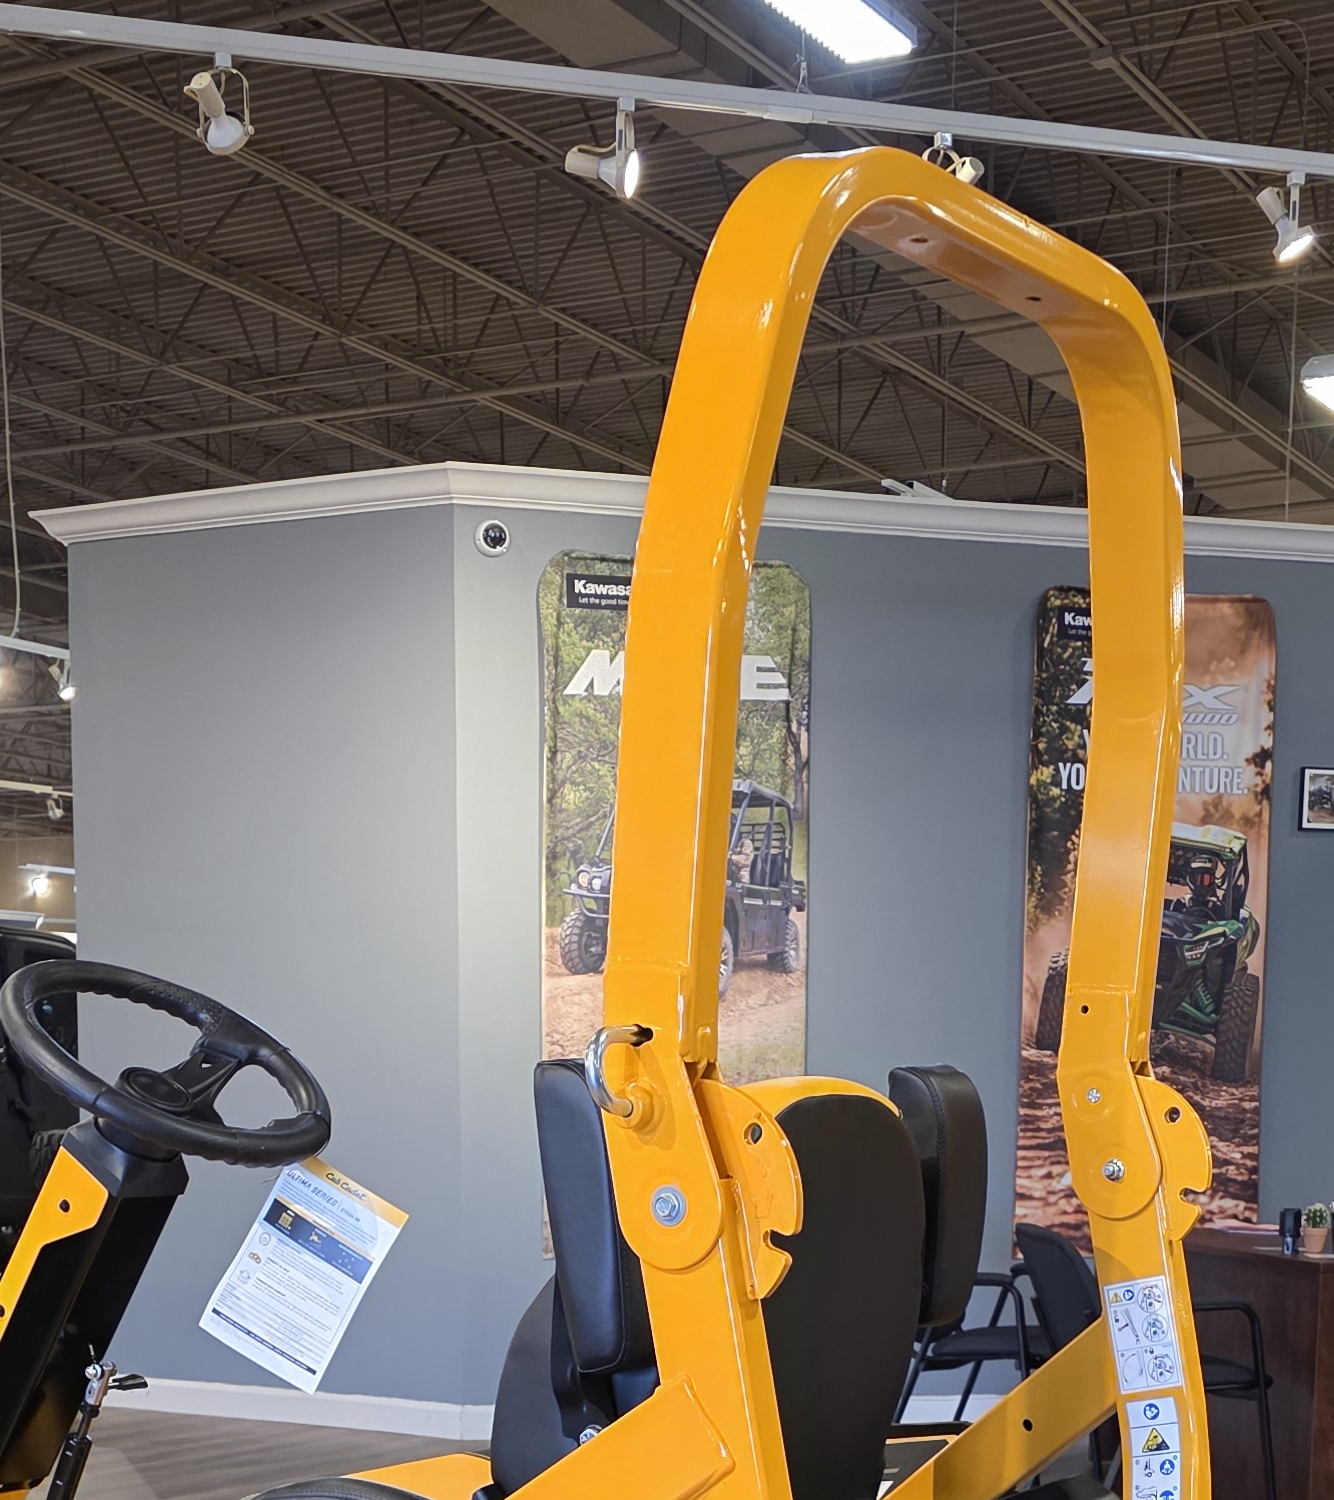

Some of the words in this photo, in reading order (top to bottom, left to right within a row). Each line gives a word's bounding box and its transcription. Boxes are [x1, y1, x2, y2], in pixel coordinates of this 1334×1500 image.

[573, 579, 633, 596] Kawasa
[563, 649, 790, 701] ME
[1181, 732, 1229, 761] RLD.
[1177, 765, 1249, 795] NTURE.
[286, 1170, 312, 1191] ULTIMA
[310, 1186, 339, 1208] SERIES
[325, 1172, 342, 1186] Cub
[340, 1181, 367, 1202] Cadet
